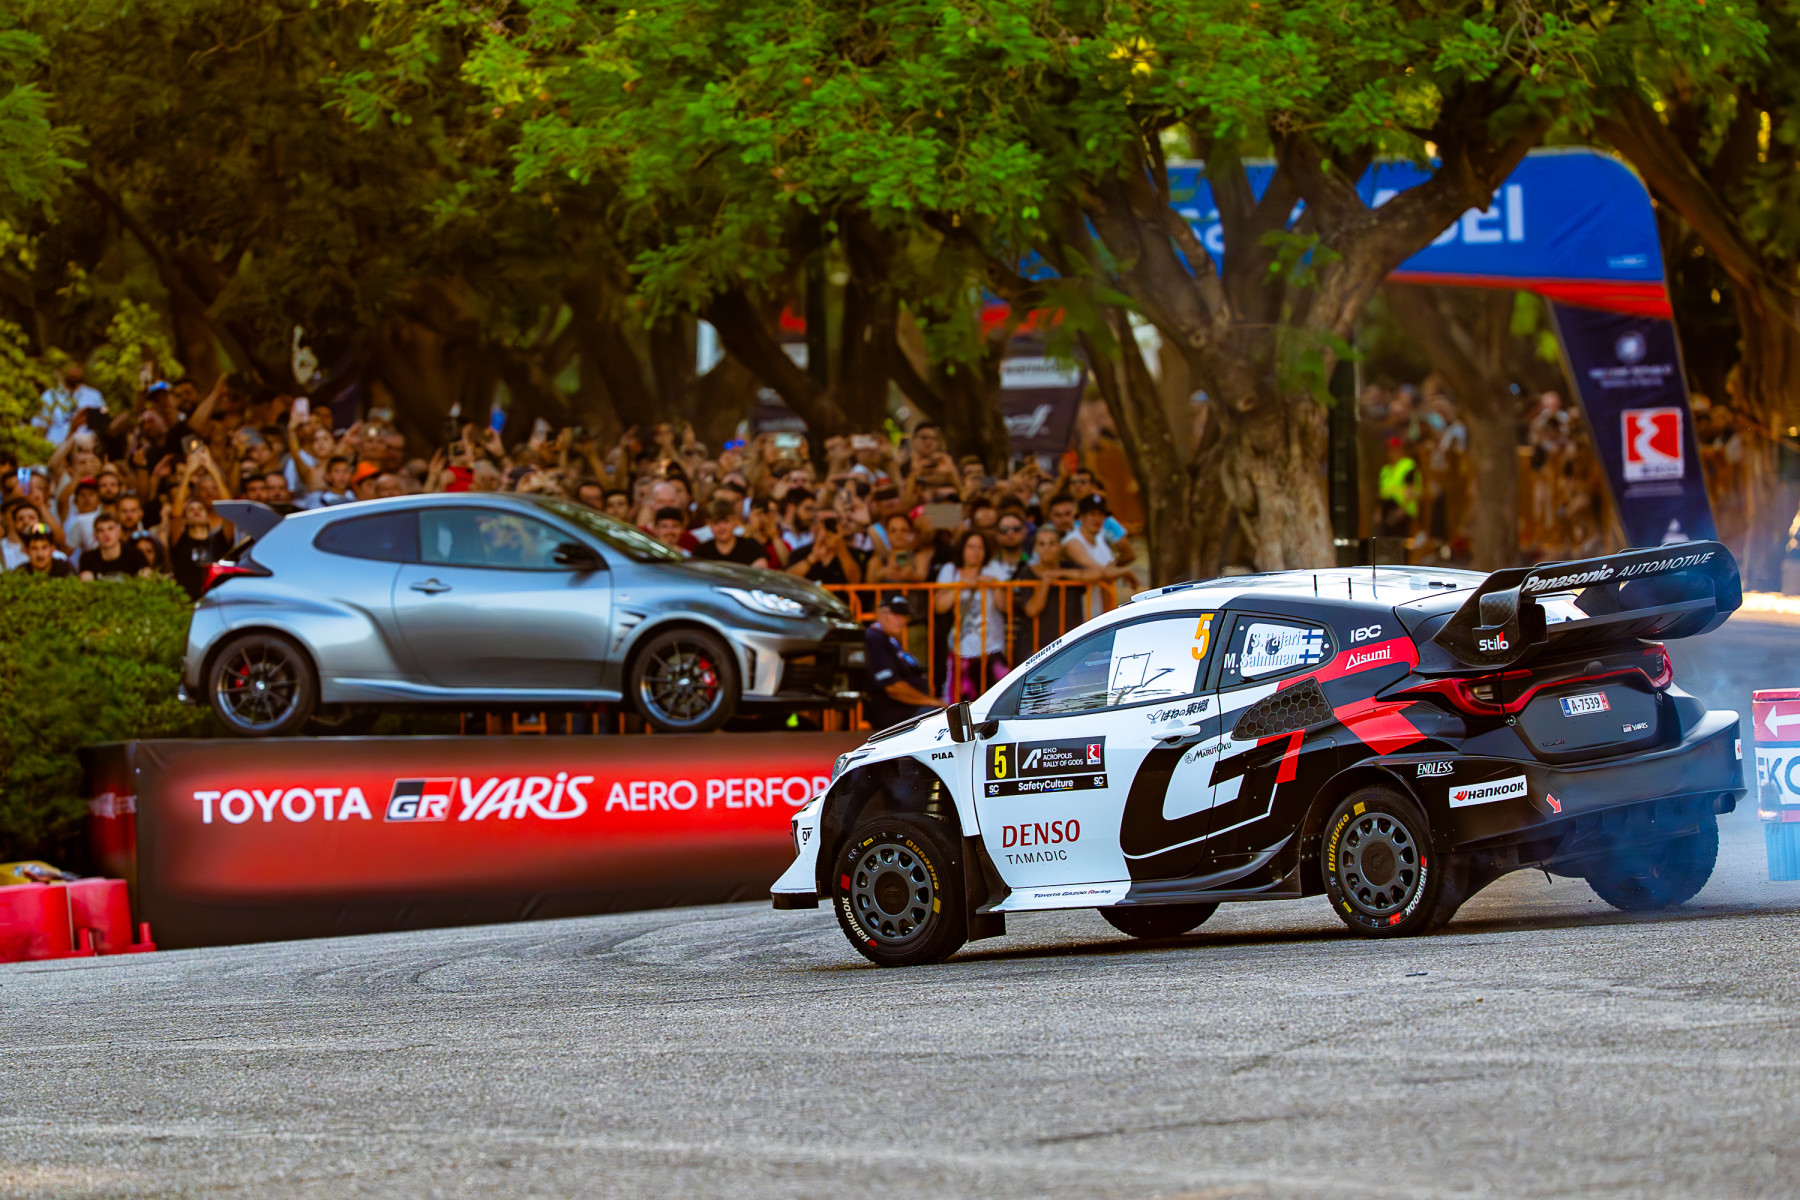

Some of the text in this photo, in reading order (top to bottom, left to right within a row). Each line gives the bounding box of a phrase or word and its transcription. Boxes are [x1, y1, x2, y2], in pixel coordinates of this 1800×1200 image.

[1522, 551, 1715, 593] Panasonic AUTOMOTIVE
[1191, 613, 1215, 661] 5
[1250, 631, 1301, 651] S. Pajari
[1479, 631, 1509, 651] Stilo
[1224, 650, 1298, 668] M. Salminen
[1345, 646, 1392, 670] Aisumi
[1571, 696, 1601, 712] A-7539
[931, 751, 955, 761] PIAA
[994, 745, 1007, 779] 5
[1416, 761, 1454, 776] ENDLESS
[988, 776, 1104, 794] SC SafetyCulture SC
[193, 787, 372, 824] TOYOTA
[387, 793, 448, 820] GR
[605, 780, 698, 812] AERO
[1002, 819, 1080, 848] DENSO
[1005, 849, 1067, 865] TAMADIC
